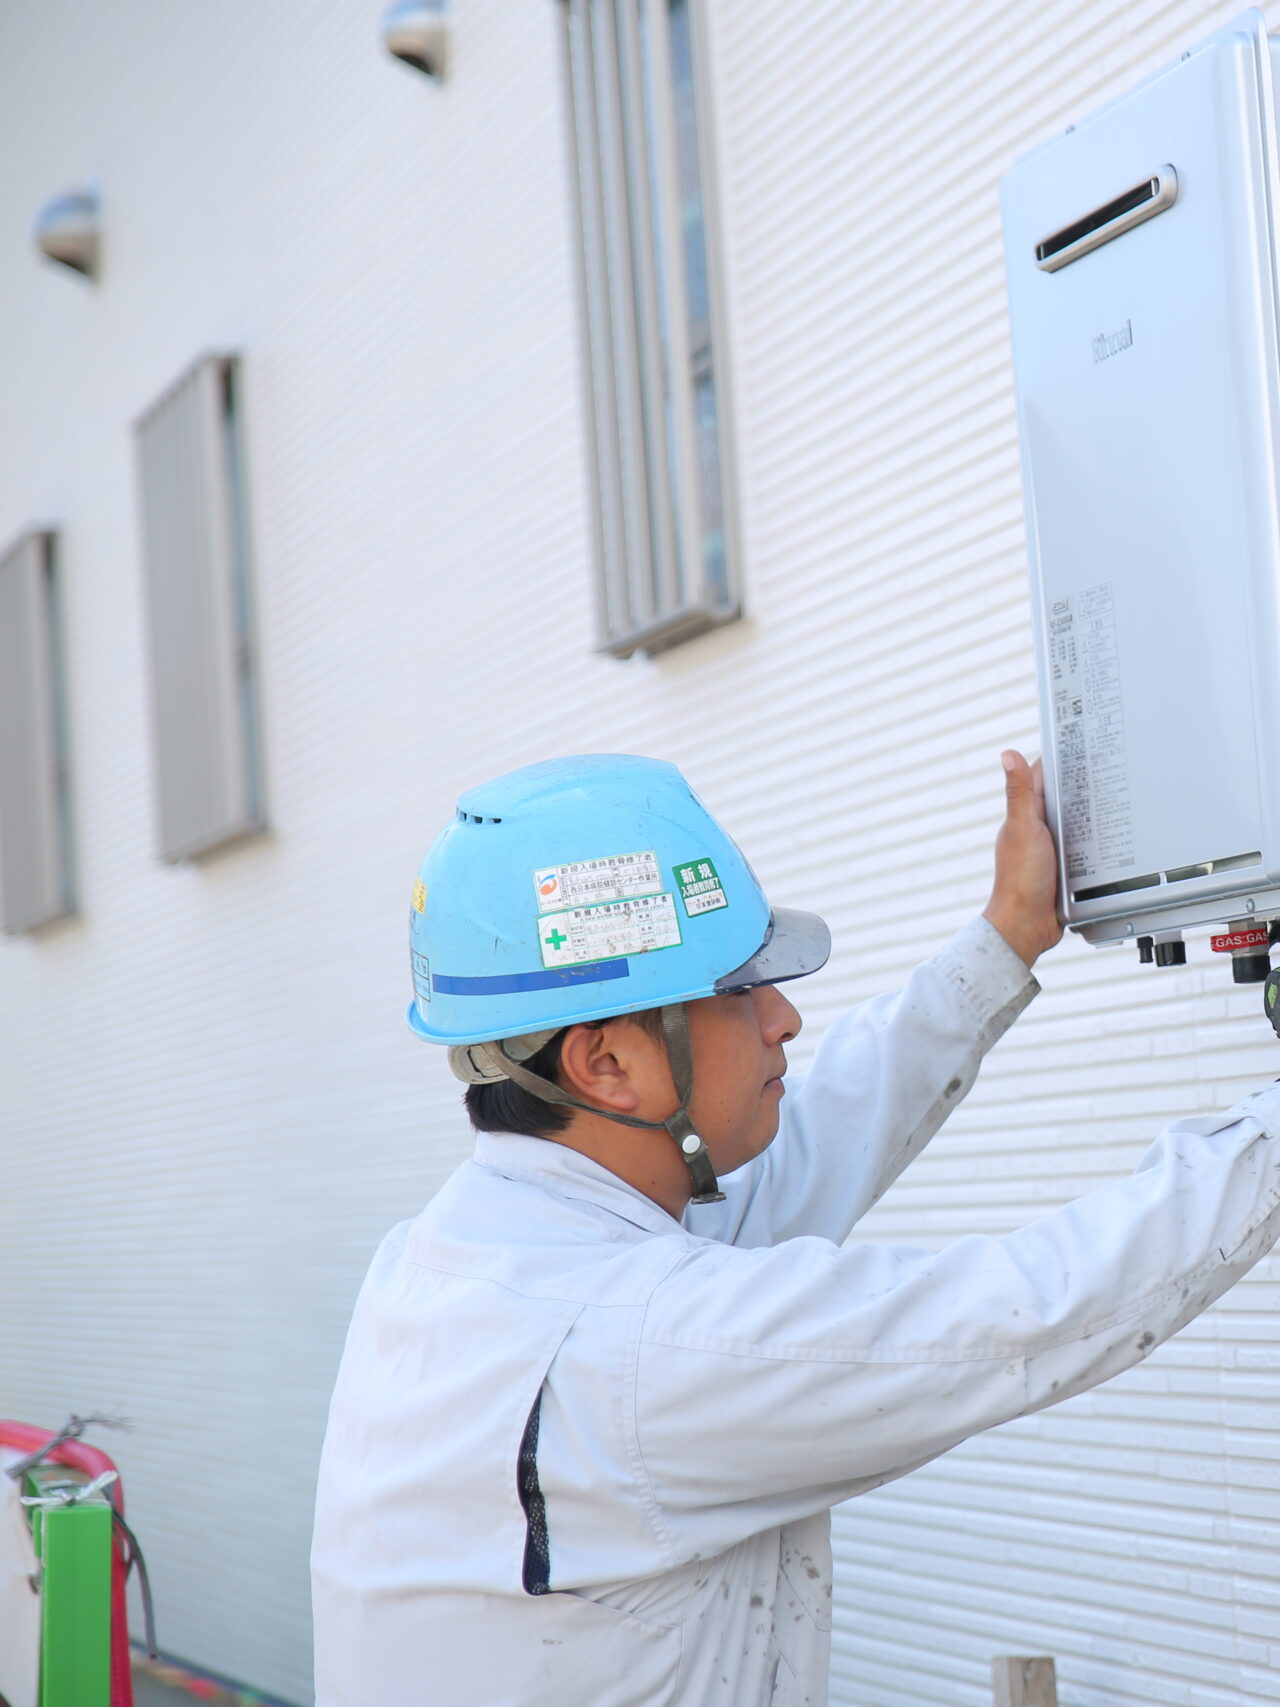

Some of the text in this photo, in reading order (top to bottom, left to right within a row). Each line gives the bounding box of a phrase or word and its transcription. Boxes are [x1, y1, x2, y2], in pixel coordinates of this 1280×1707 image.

[560, 854, 652, 875] 新規入場時教育修了者
[680, 863, 713, 884] 新規
[574, 896, 667, 918] 新規入場時教育修了者
[1216, 936, 1242, 947] GAS
